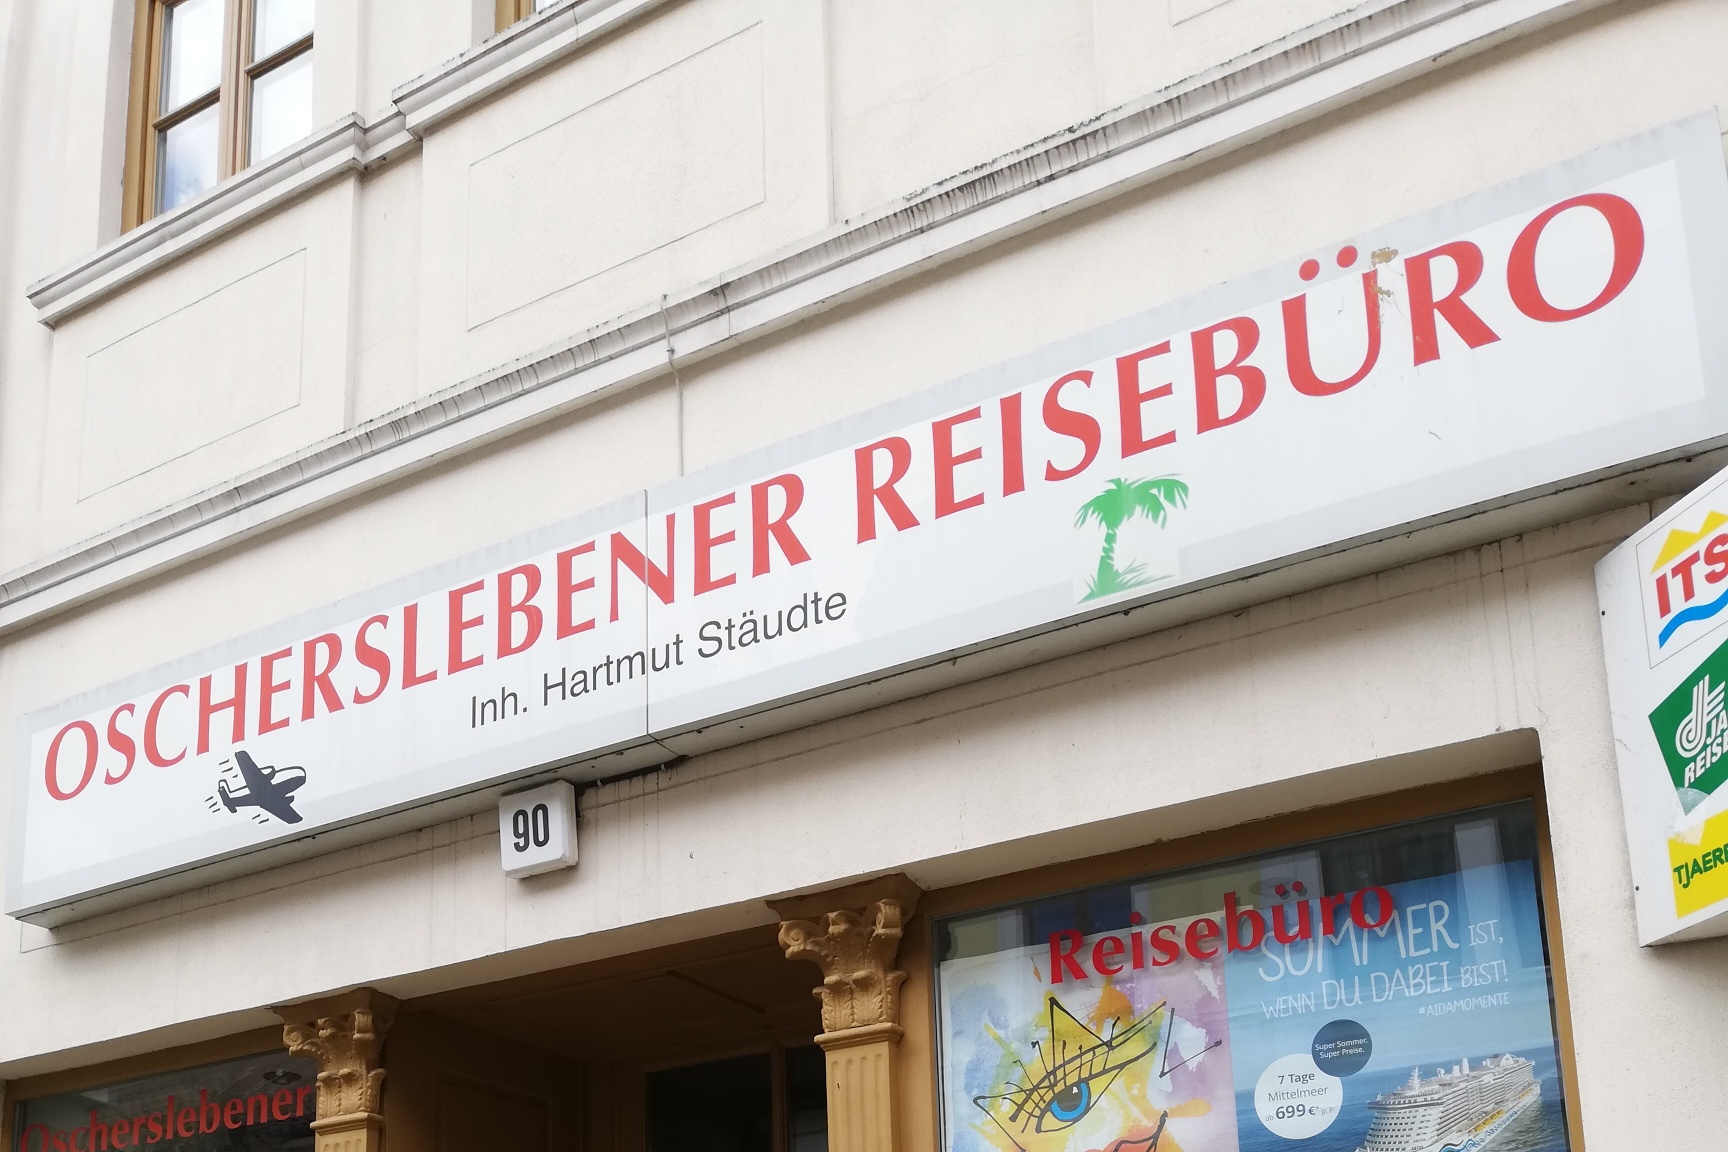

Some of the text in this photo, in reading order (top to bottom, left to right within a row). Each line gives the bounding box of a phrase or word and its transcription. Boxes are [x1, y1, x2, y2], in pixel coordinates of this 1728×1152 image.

[44, 192, 1645, 801] OSCHERSLEBENER REISEBÜRO
[1655, 532, 1728, 619] ITS
[470, 588, 848, 729] Inh. Hartmut Stäudte
[512, 803, 549, 853] 90
[1050, 880, 1394, 985] Reisebüro
[1258, 900, 1504, 982] SOMMER IST,
[1261, 959, 1509, 1020] WENN DU DABEI BIST!
[1418, 992, 1510, 1017] #AIDAMOMENTE
[1315, 1038, 1368, 1052] Super Sommer.
[1320, 1047, 1365, 1059] Super Preise.
[1268, 1086, 1329, 1102] Mittelmeer
[1278, 1072, 1315, 1084] 7 Tage
